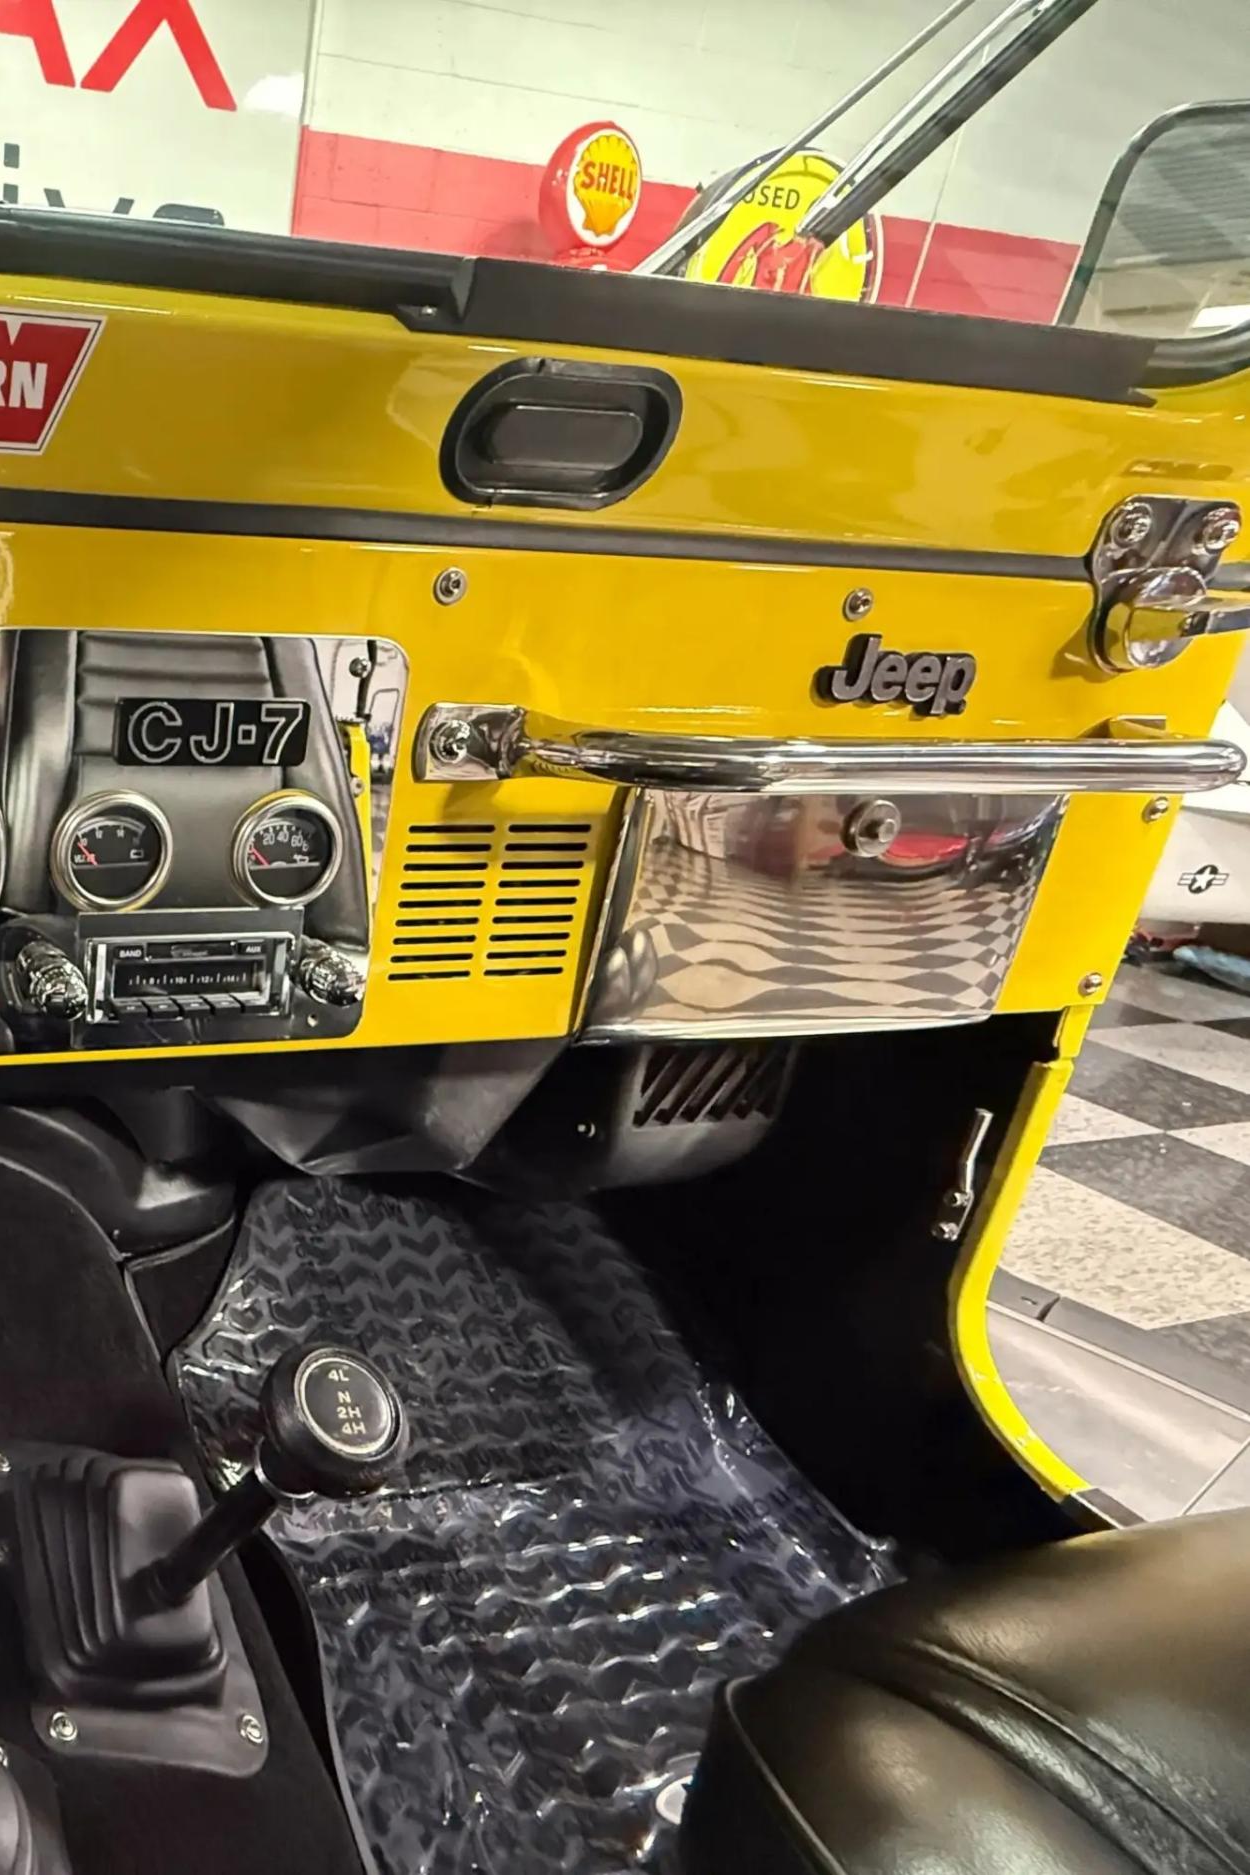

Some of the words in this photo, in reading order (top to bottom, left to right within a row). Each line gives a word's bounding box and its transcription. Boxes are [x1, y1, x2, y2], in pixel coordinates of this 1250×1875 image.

[580, 160, 634, 201] SHELL
[829, 634, 977, 716] Jeep
[127, 701, 305, 764] CJ-7
[262, 832, 275, 846] 20
[291, 834, 303, 848] 60
[119, 949, 142, 958] BAND
[245, 945, 261, 953] AUX
[327, 1369, 349, 1381] 4L
[337, 1391, 352, 1404] N
[336, 1406, 362, 1419] 2H
[341, 1422, 367, 1435] 4H
